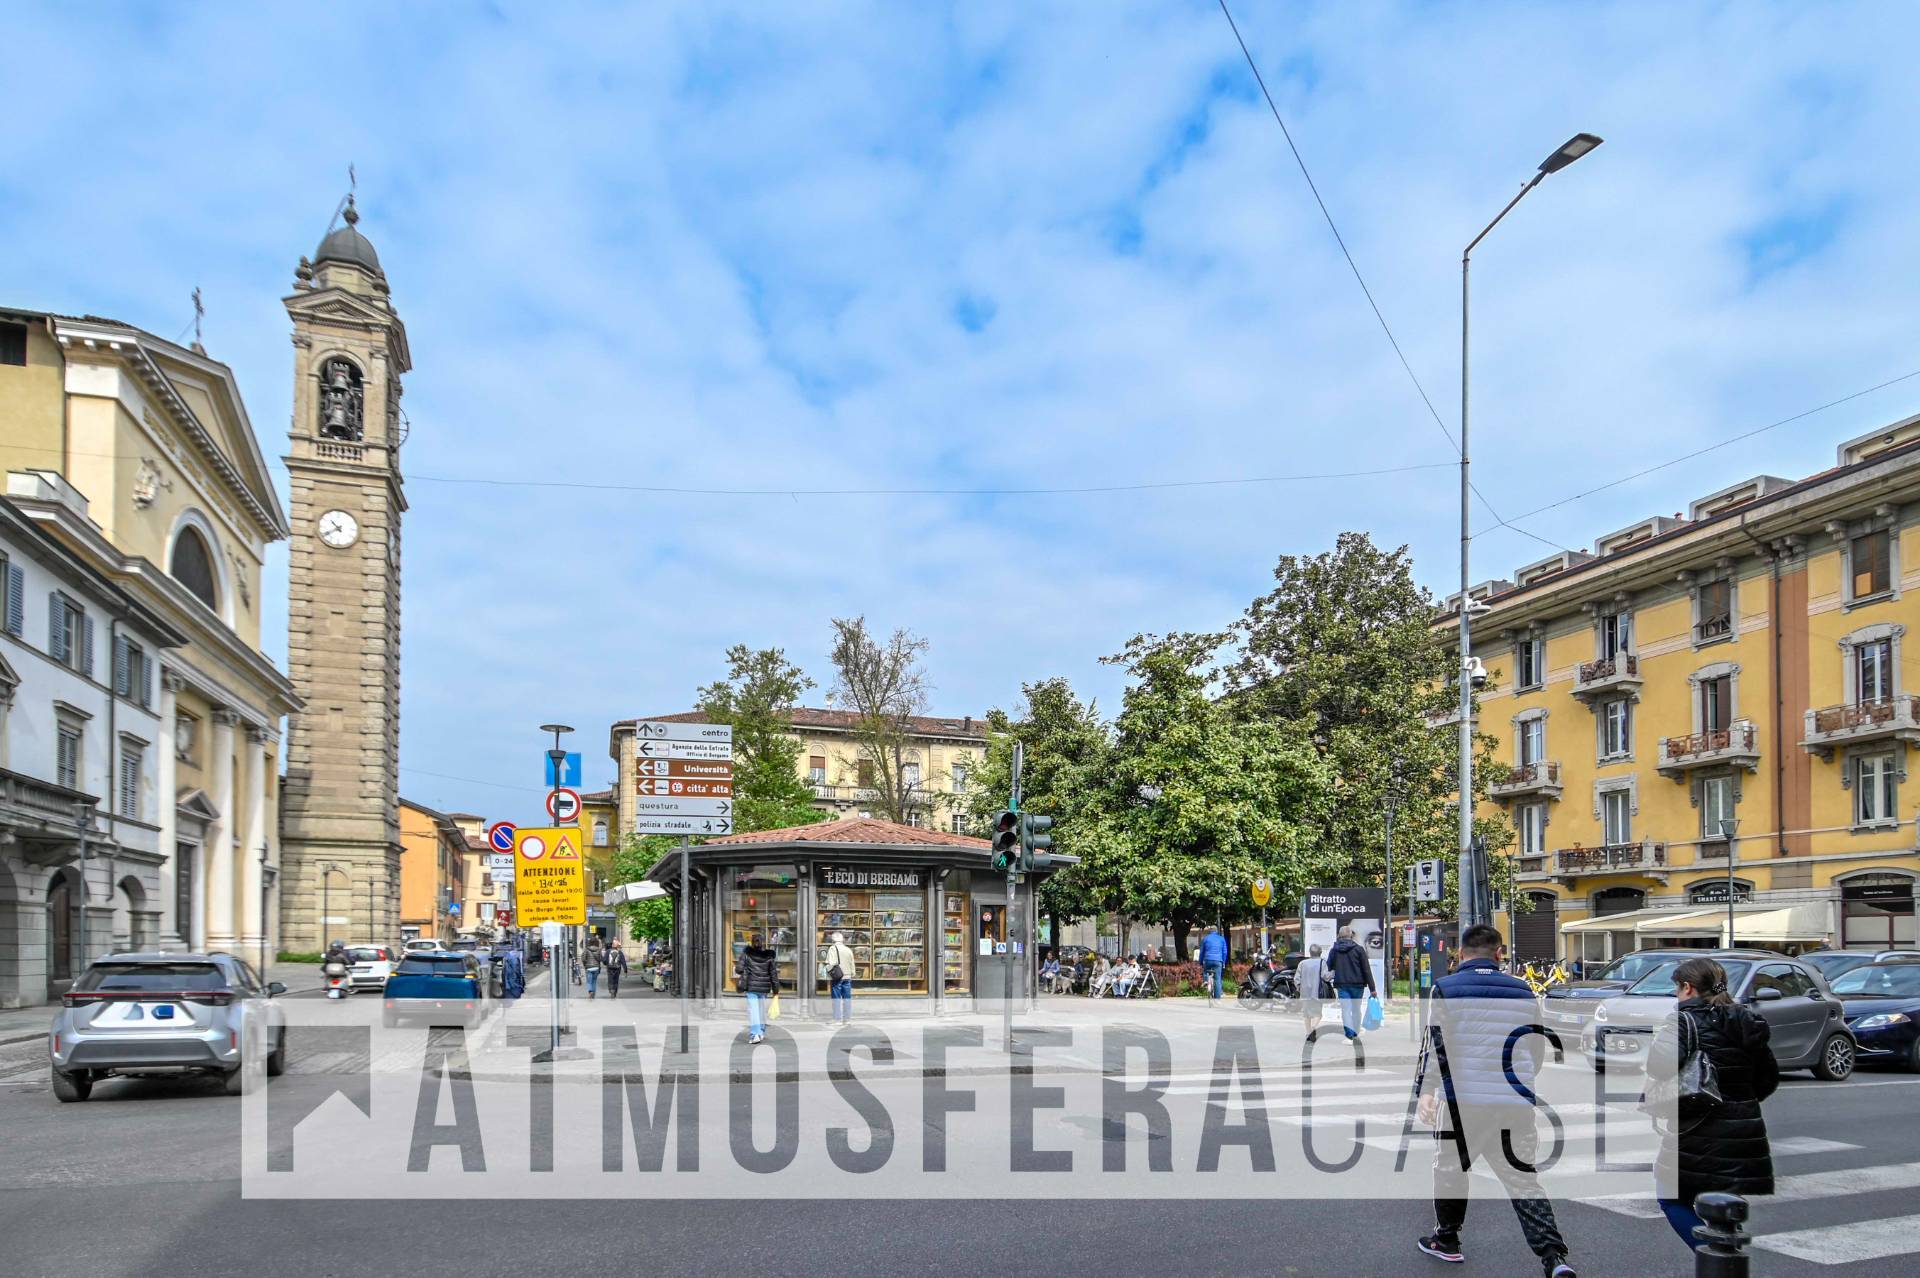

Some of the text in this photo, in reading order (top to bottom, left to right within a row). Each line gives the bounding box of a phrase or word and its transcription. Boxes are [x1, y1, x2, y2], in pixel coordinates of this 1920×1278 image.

[701, 729, 729, 737] centro
[711, 784, 729, 794] alta
[523, 867, 576, 877] ATTENZIONE
[826, 871, 919, 886] L'ECO DI BERGAMO
[1310, 894, 1346, 904] Ritratto
[1697, 895, 1717, 903] SMART
[1310, 903, 1366, 915] di un'Epoca
